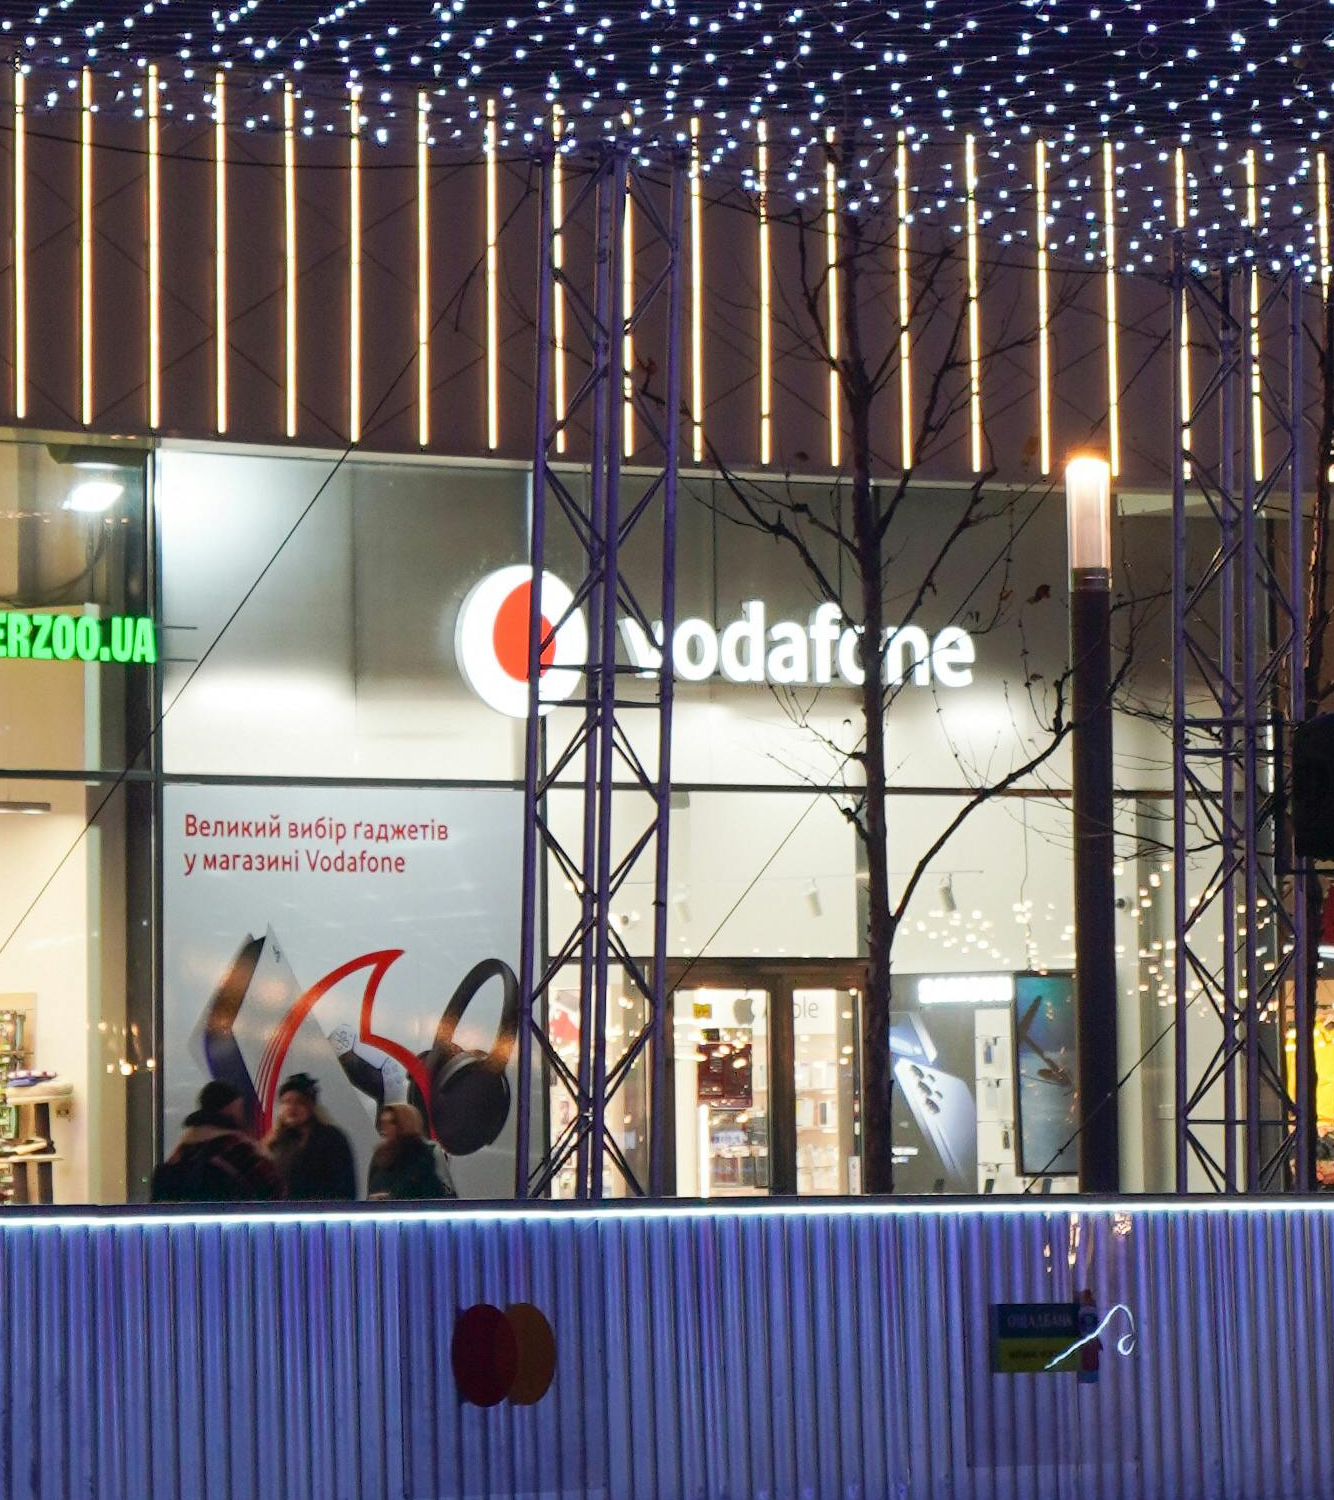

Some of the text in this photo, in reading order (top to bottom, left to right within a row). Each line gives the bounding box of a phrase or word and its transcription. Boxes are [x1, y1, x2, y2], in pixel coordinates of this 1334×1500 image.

[185, 813, 448, 844] Великий вибір ґаджетів
[183, 849, 406, 876] у магазині Vodafone
